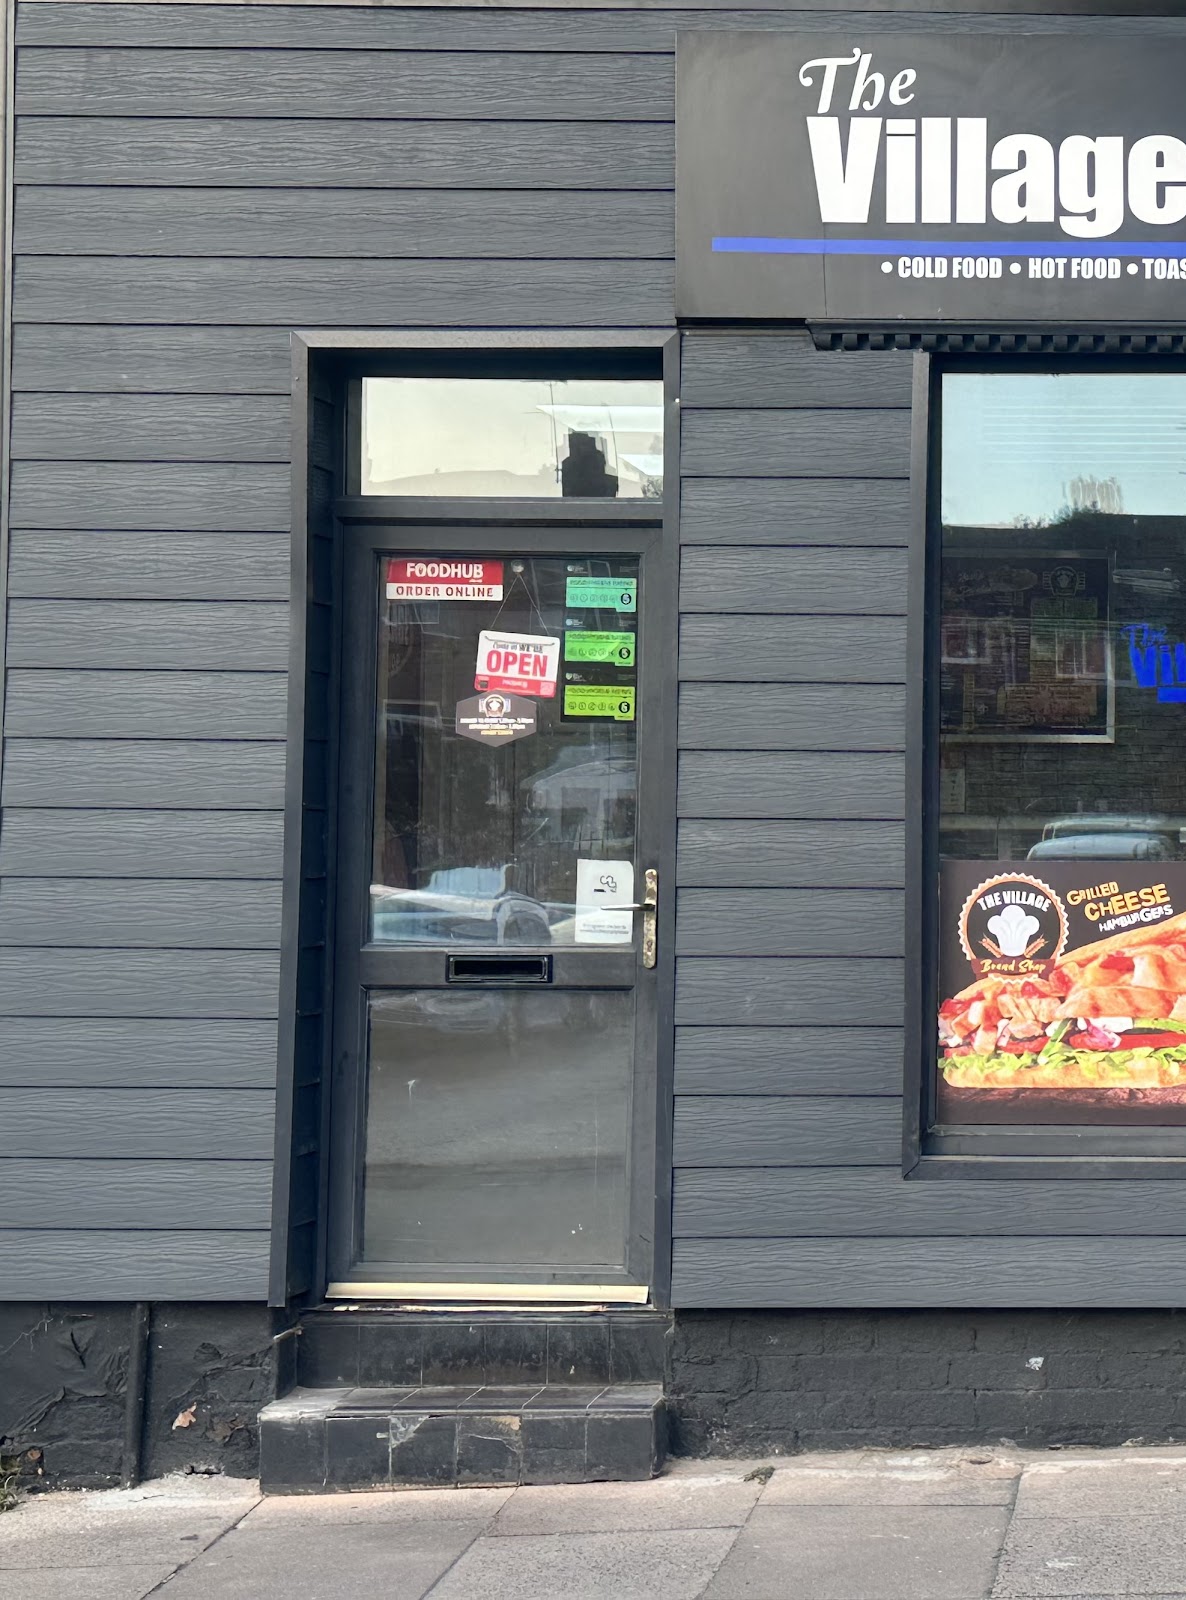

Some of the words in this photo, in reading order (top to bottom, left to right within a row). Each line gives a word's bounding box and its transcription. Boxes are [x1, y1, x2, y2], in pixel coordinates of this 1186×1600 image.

[799, 47, 916, 113] The
[898, 256, 948, 279] COLD
[953, 257, 1003, 279] FOOD
[1028, 257, 1067, 280] HOT
[1071, 257, 1121, 280] FOOD
[406, 563, 484, 579] FOODHUB
[396, 586, 440, 597] ORDER
[446, 586, 494, 598] ONLINE
[487, 650, 548, 677] OPEN
[977, 892, 1002, 911] THE
[1003, 891, 1051, 912] VILLAGE
[1066, 881, 1119, 906] GRILLED
[1084, 883, 1171, 921] CHEESE
[980, 959, 1015, 973] Bread
[1018, 959, 1046, 974] Shop
